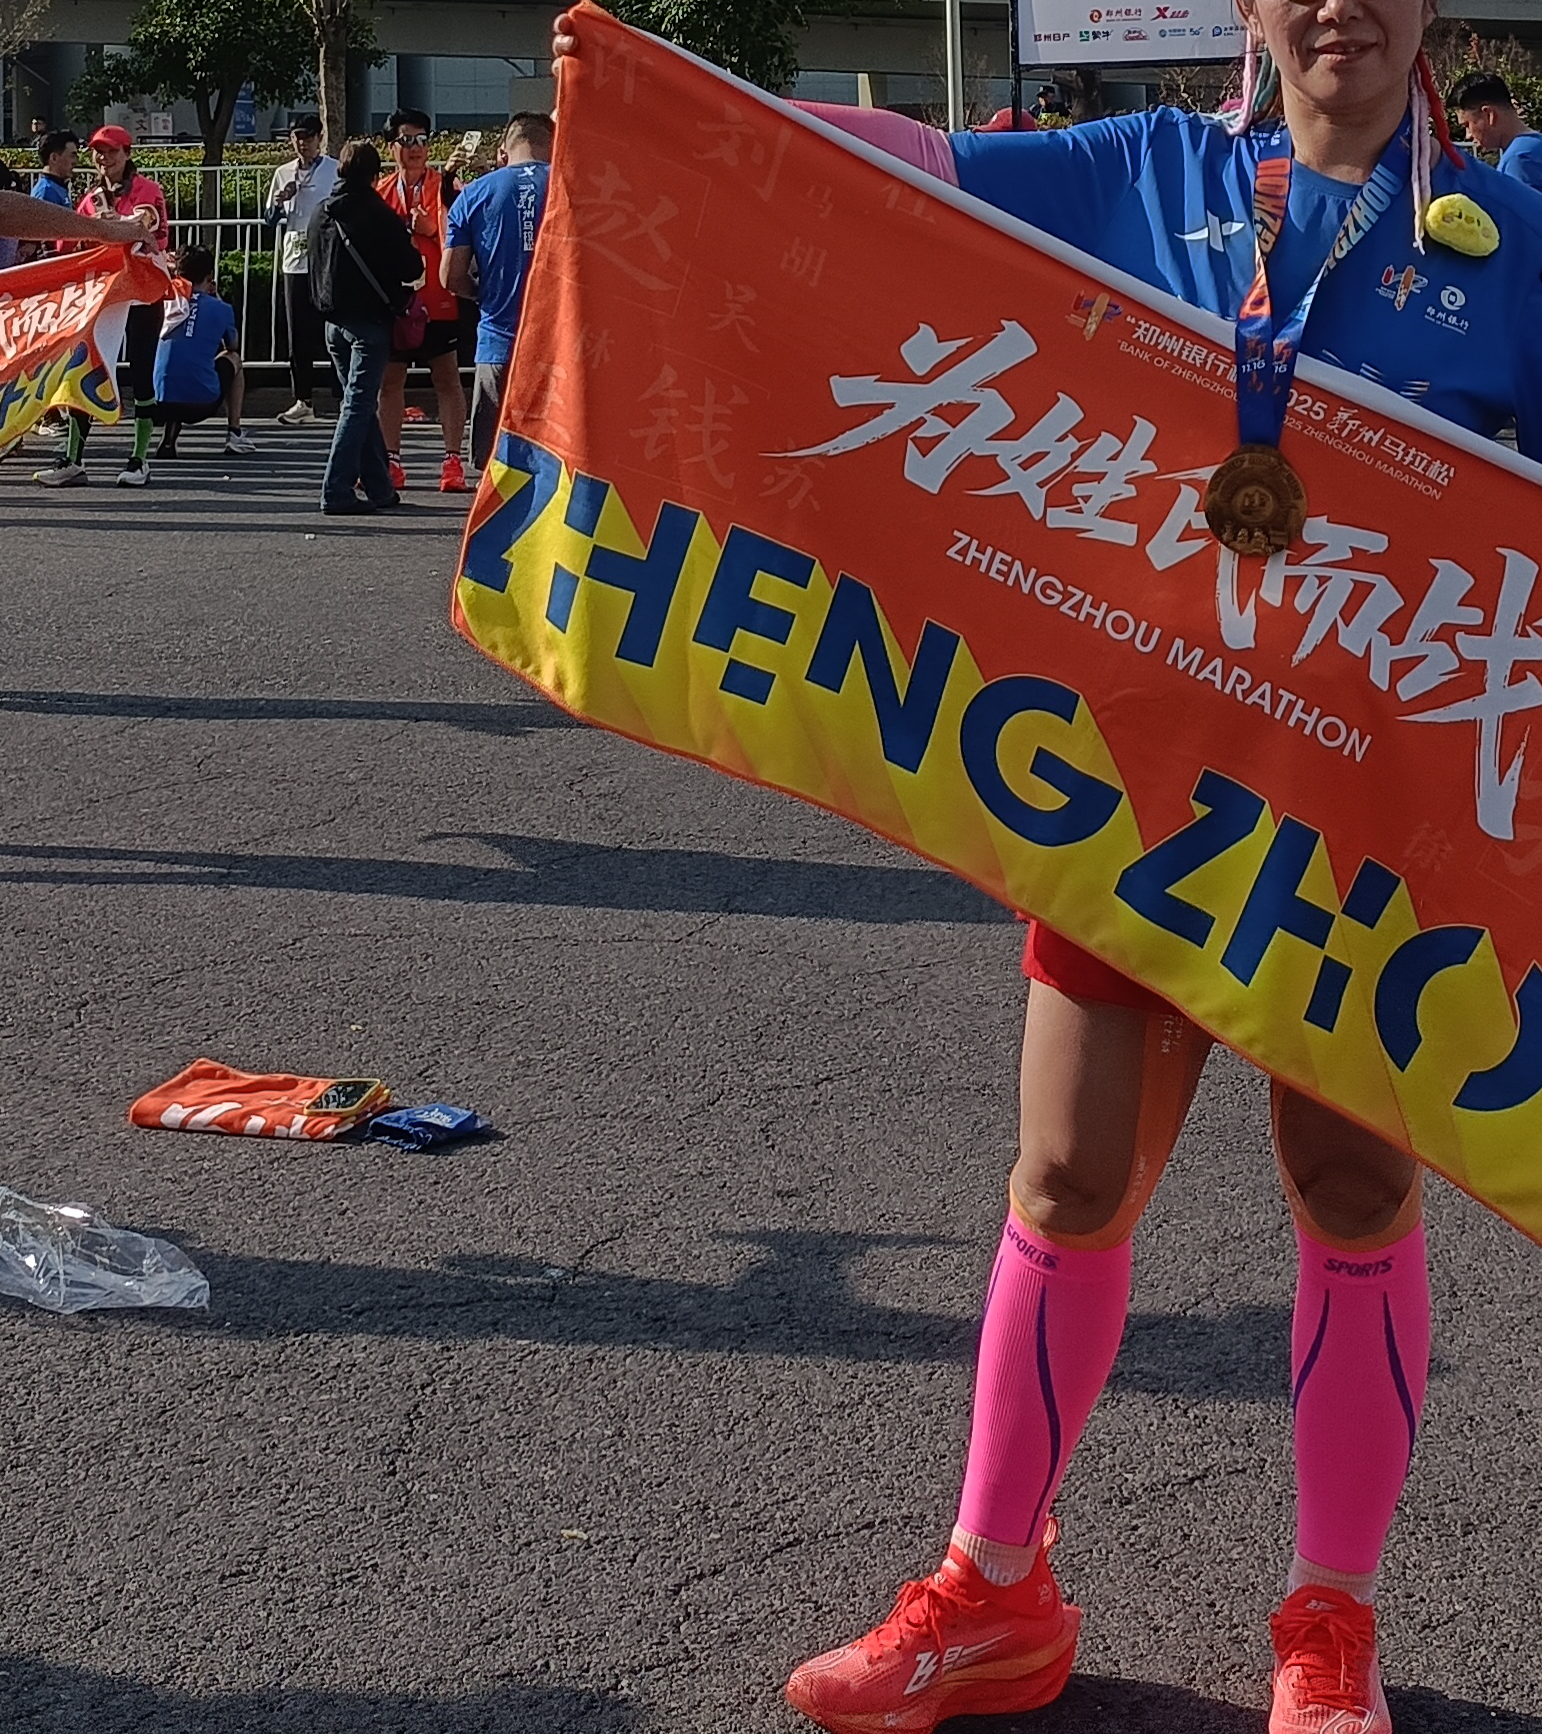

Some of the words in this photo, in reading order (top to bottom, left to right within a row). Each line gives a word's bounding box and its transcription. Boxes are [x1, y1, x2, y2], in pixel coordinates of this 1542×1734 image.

[1153, 357, 1171, 370] OF
[1302, 426, 1375, 465] ZHENGZHOU
[1374, 460, 1443, 500] MARATHON
[1326, 406, 1455, 487] 郑州马拉松
[462, 430, 1124, 847] ZHENG
[945, 529, 1162, 655] ZHENGZHOU
[1165, 636, 1373, 764] MARATHON
[1004, 1222, 1060, 1270] SPORTS
[1323, 1255, 1394, 1278] SPORTS
